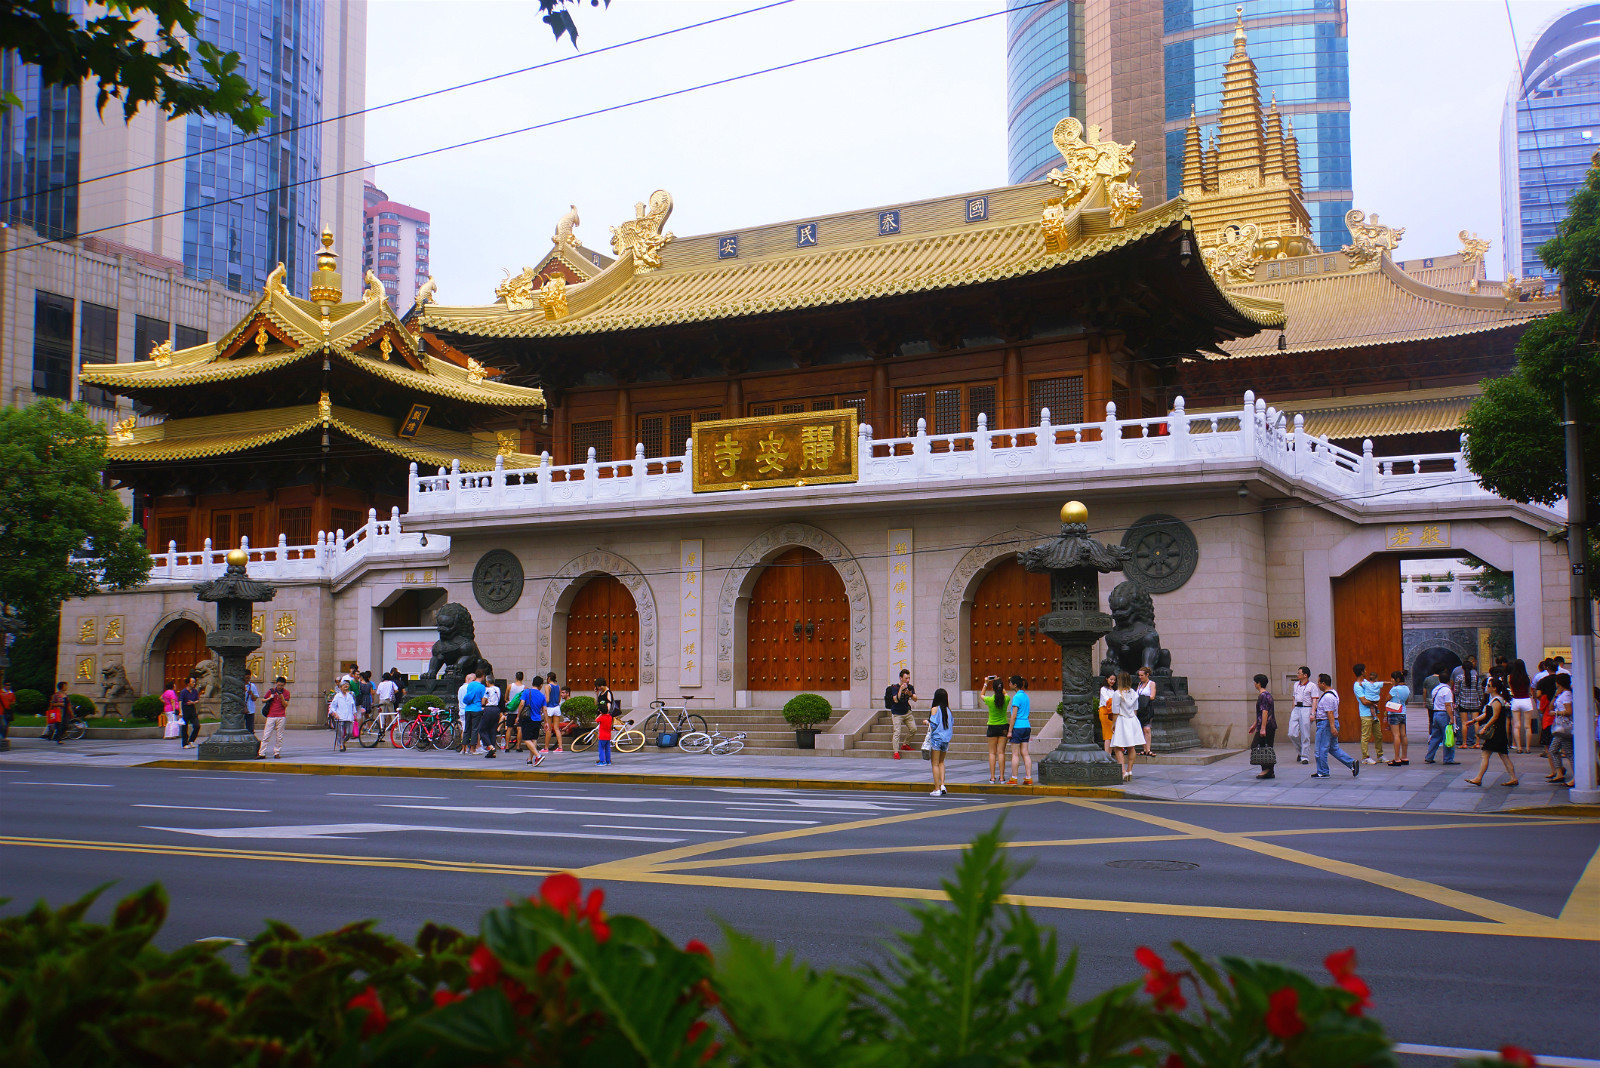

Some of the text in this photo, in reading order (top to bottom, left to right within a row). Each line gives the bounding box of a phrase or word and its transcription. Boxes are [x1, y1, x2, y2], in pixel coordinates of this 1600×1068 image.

[721, 199, 985, 255] 國泰民安
[1276, 621, 1298, 630] 1686
